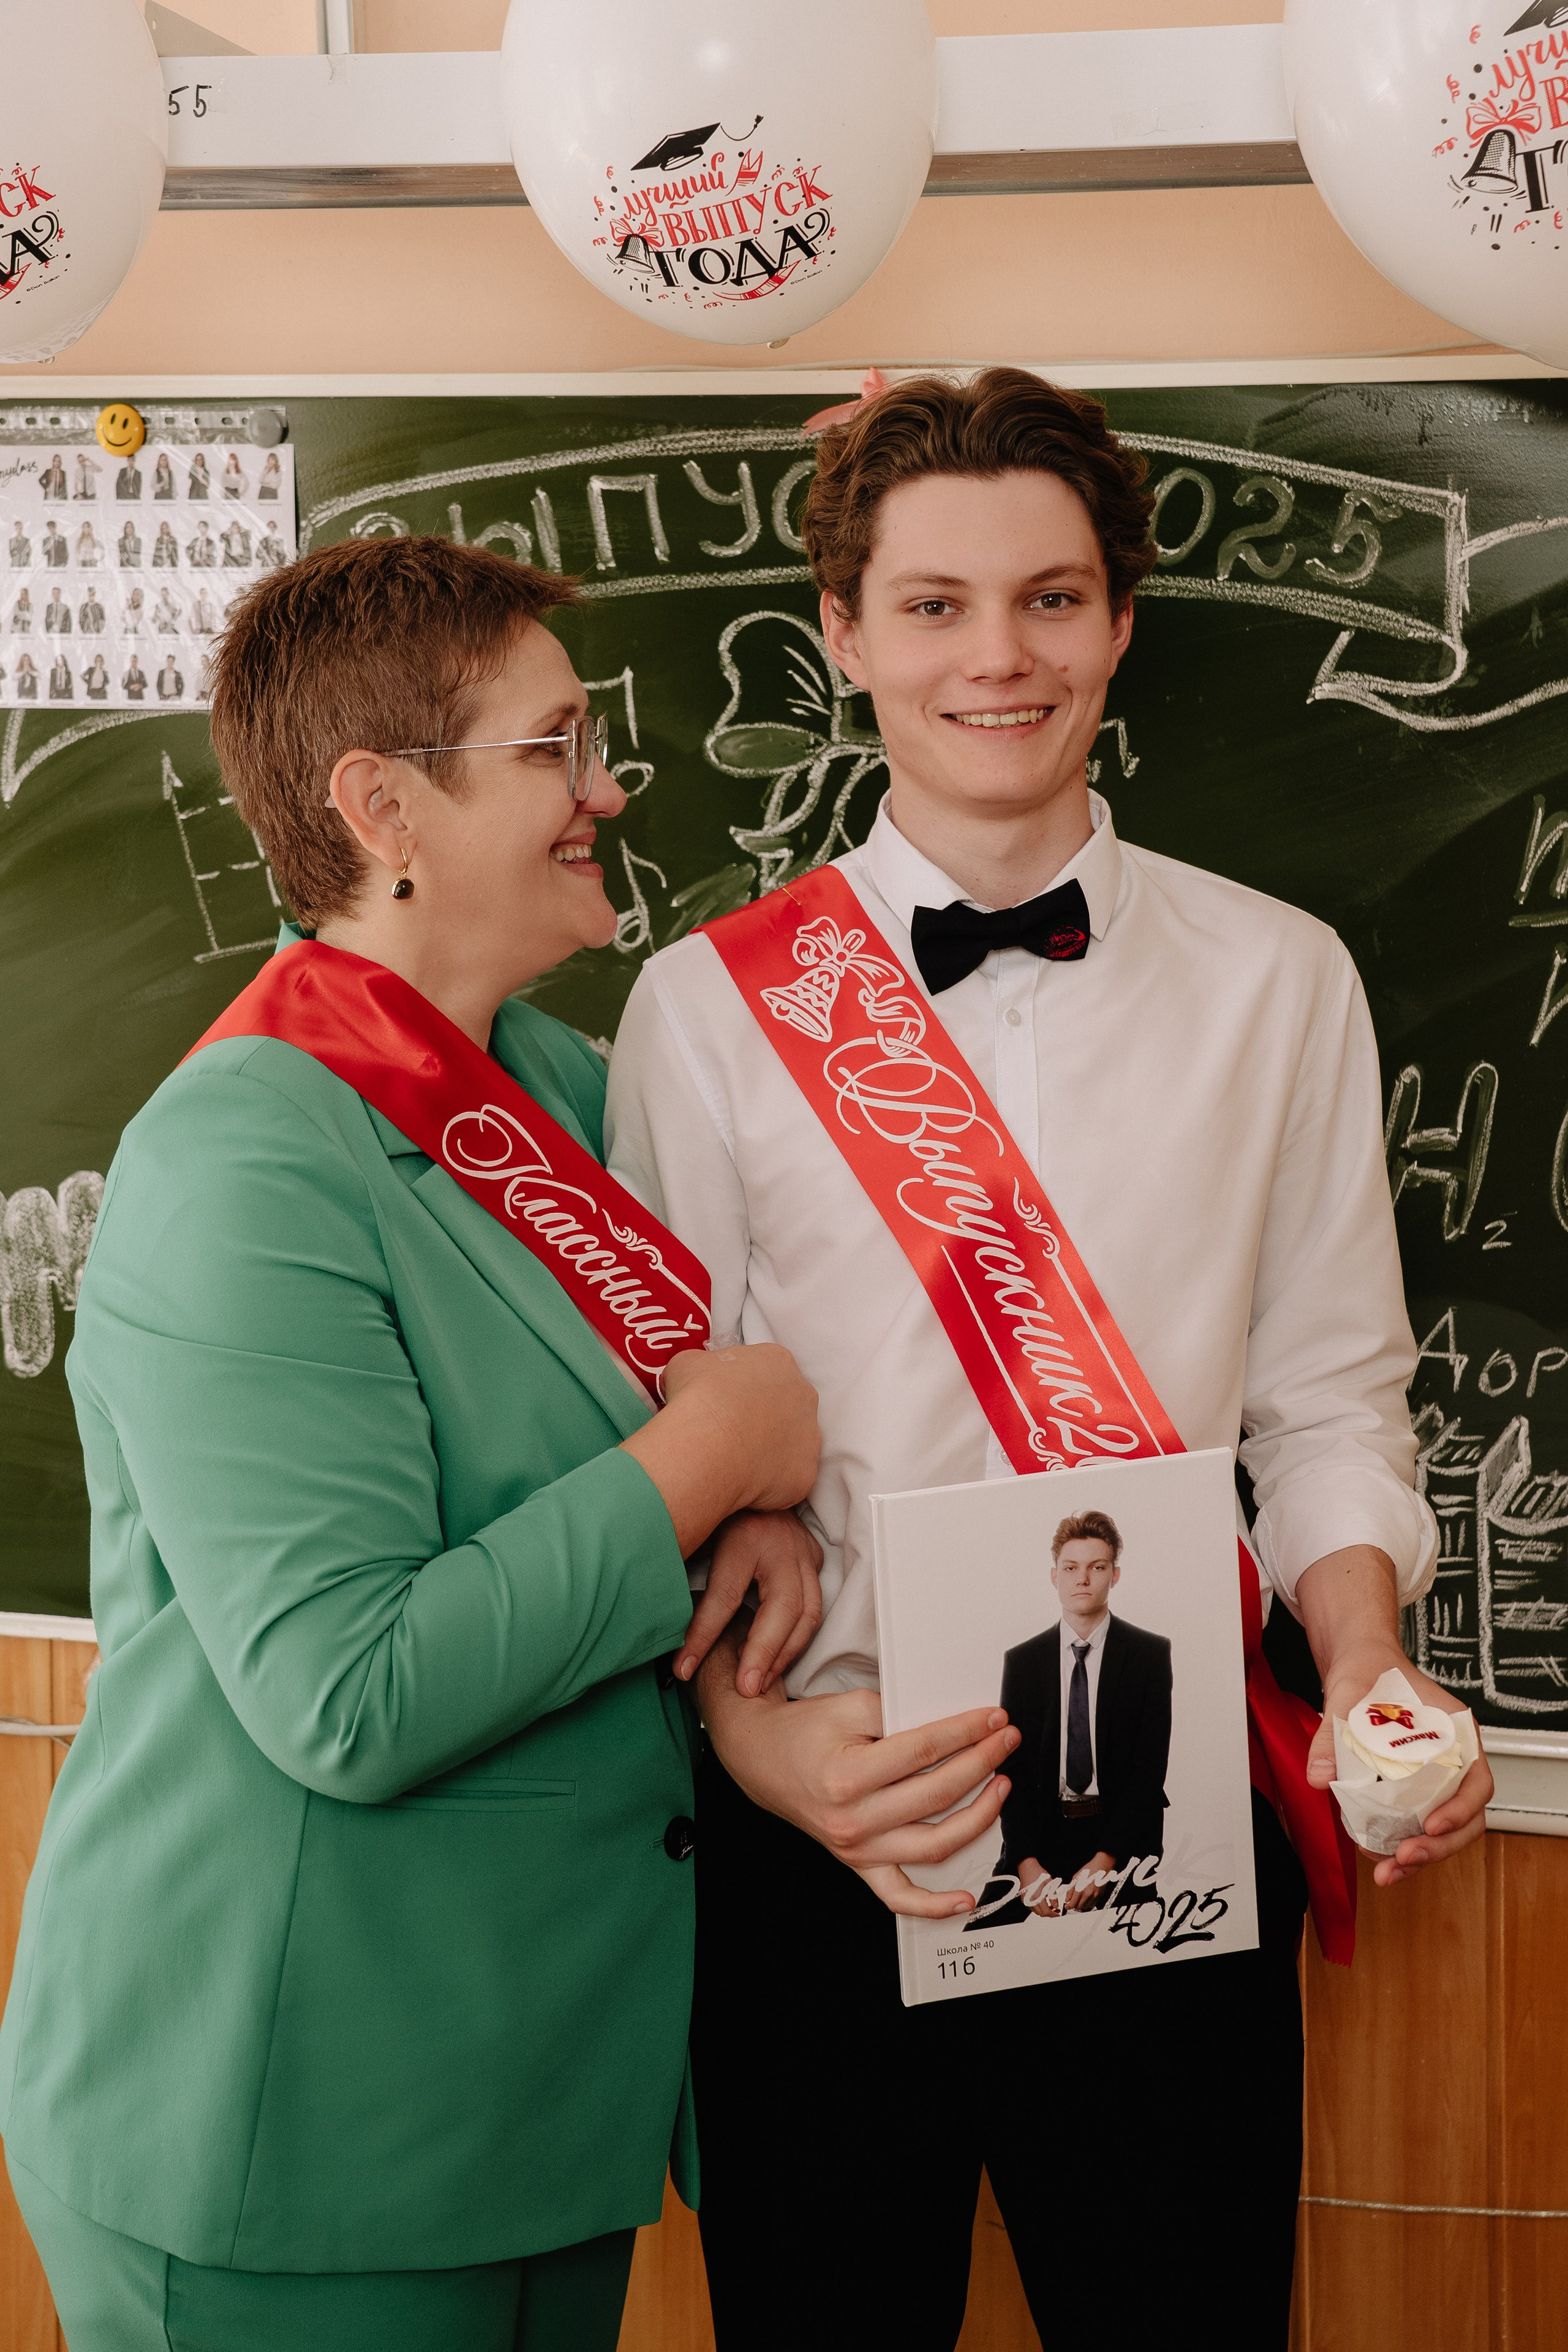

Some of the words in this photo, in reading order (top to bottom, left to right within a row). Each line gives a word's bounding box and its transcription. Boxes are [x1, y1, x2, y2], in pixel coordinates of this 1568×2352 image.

[168, 84, 212, 118] 55
[623, 152, 729, 225] лучший
[659, 165, 833, 247] ВЫПУСК
[649, 208, 831, 287] ГОДА
[1150, 467, 1403, 588] 025
[441, 1104, 704, 1350] Классный
[823, 1036, 1102, 1419] Выпускник
[1046, 1416, 1140, 1468] 2
[1389, 1730, 1441, 1748] Максим
[937, 1945, 968, 1956] Школа
[970, 1942, 981, 1951] №
[983, 1940, 994, 1949] 40
[1107, 1883, 1235, 1954] 2025
